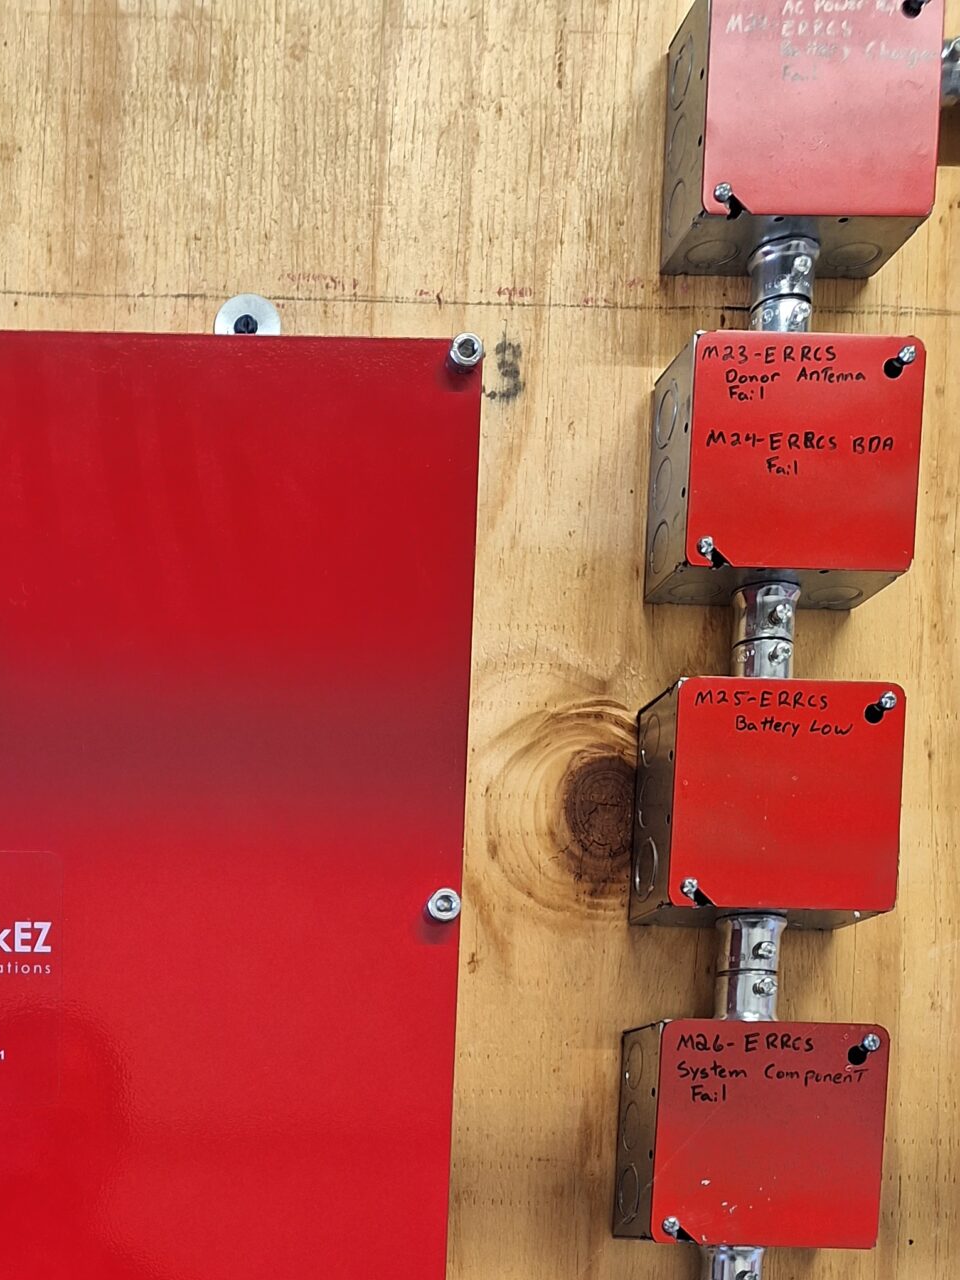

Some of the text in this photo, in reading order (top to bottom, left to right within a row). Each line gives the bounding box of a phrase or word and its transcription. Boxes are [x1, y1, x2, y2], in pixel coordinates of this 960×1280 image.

[701, 345, 837, 363] M23-ERRCS
[725, 369, 780, 384] Donor
[729, 385, 765, 402] Fail
[851, 436, 895, 454] BDA
[766, 456, 799, 476] Fail
[695, 690, 829, 710] M25-ERRCS
[735, 715, 800, 737] Battery
[676, 1060, 748, 1079] System
[690, 1084, 728, 1103] Fail
